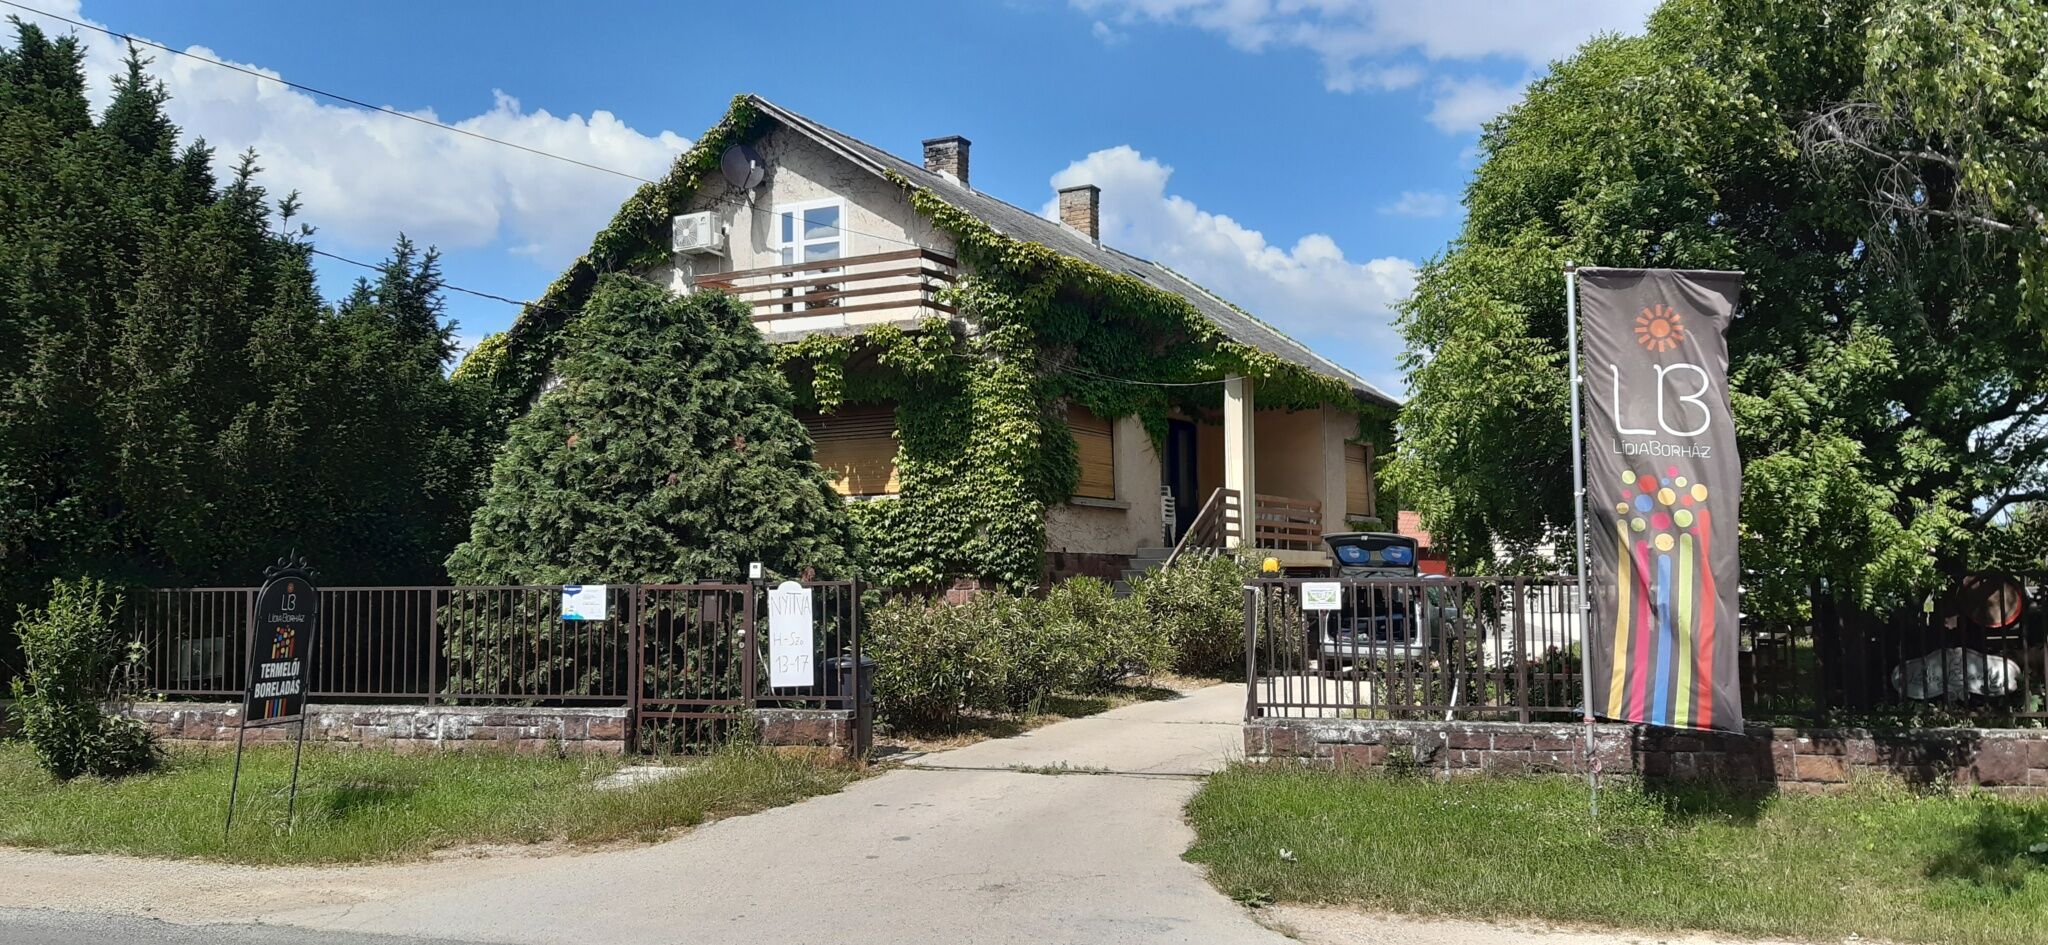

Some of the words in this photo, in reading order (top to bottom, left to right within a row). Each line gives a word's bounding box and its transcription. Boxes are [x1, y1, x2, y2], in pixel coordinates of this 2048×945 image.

[1609, 363, 1711, 437] LB
[281, 593, 296, 611] LB
[770, 592, 811, 616] NYITVA
[254, 677, 301, 698] BORELADÁS
